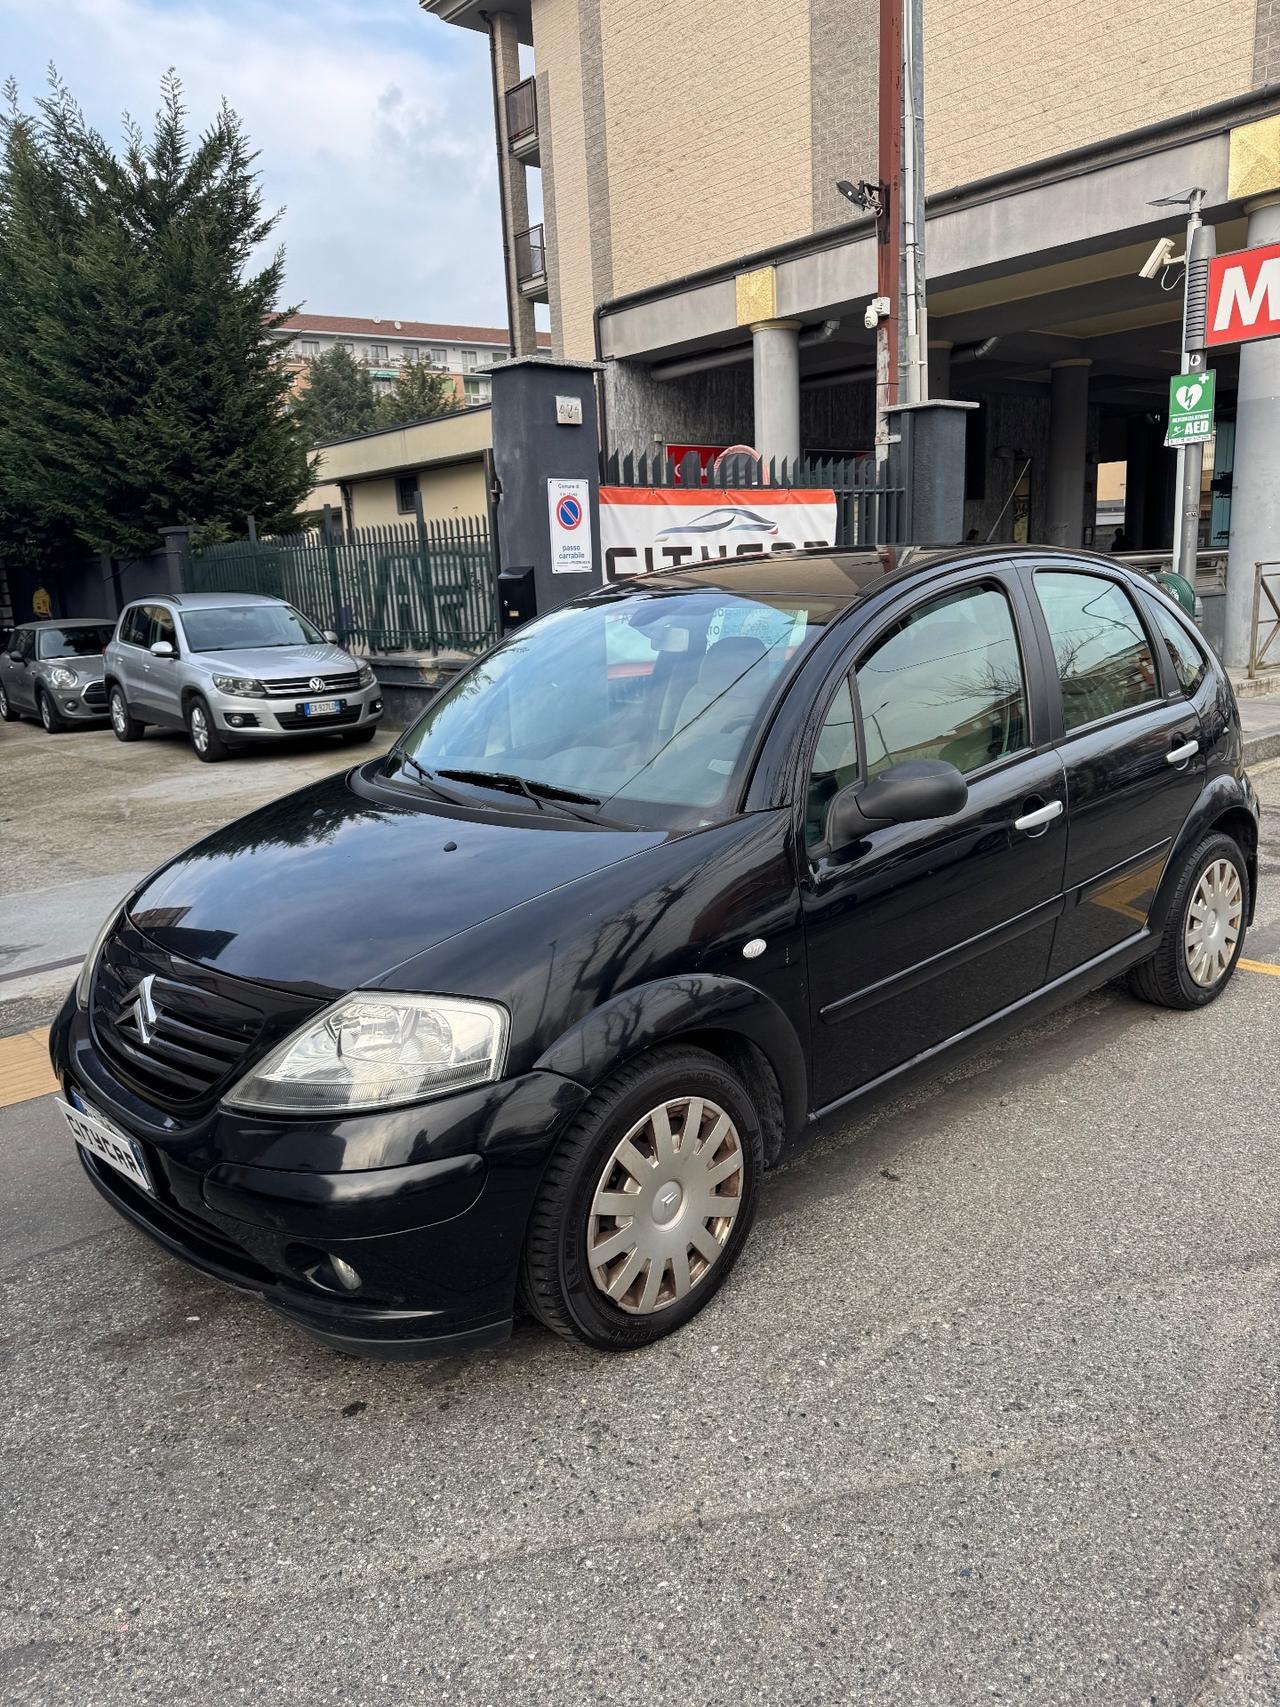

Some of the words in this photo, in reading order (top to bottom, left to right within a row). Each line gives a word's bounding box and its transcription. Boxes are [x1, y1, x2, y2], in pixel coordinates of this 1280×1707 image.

[1213, 257, 1280, 331] M
[1185, 420, 1209, 434] AED
[558, 551, 585, 560] carrabile
[562, 545, 581, 553] passo
[65, 1113, 142, 1178] CITYCAR
